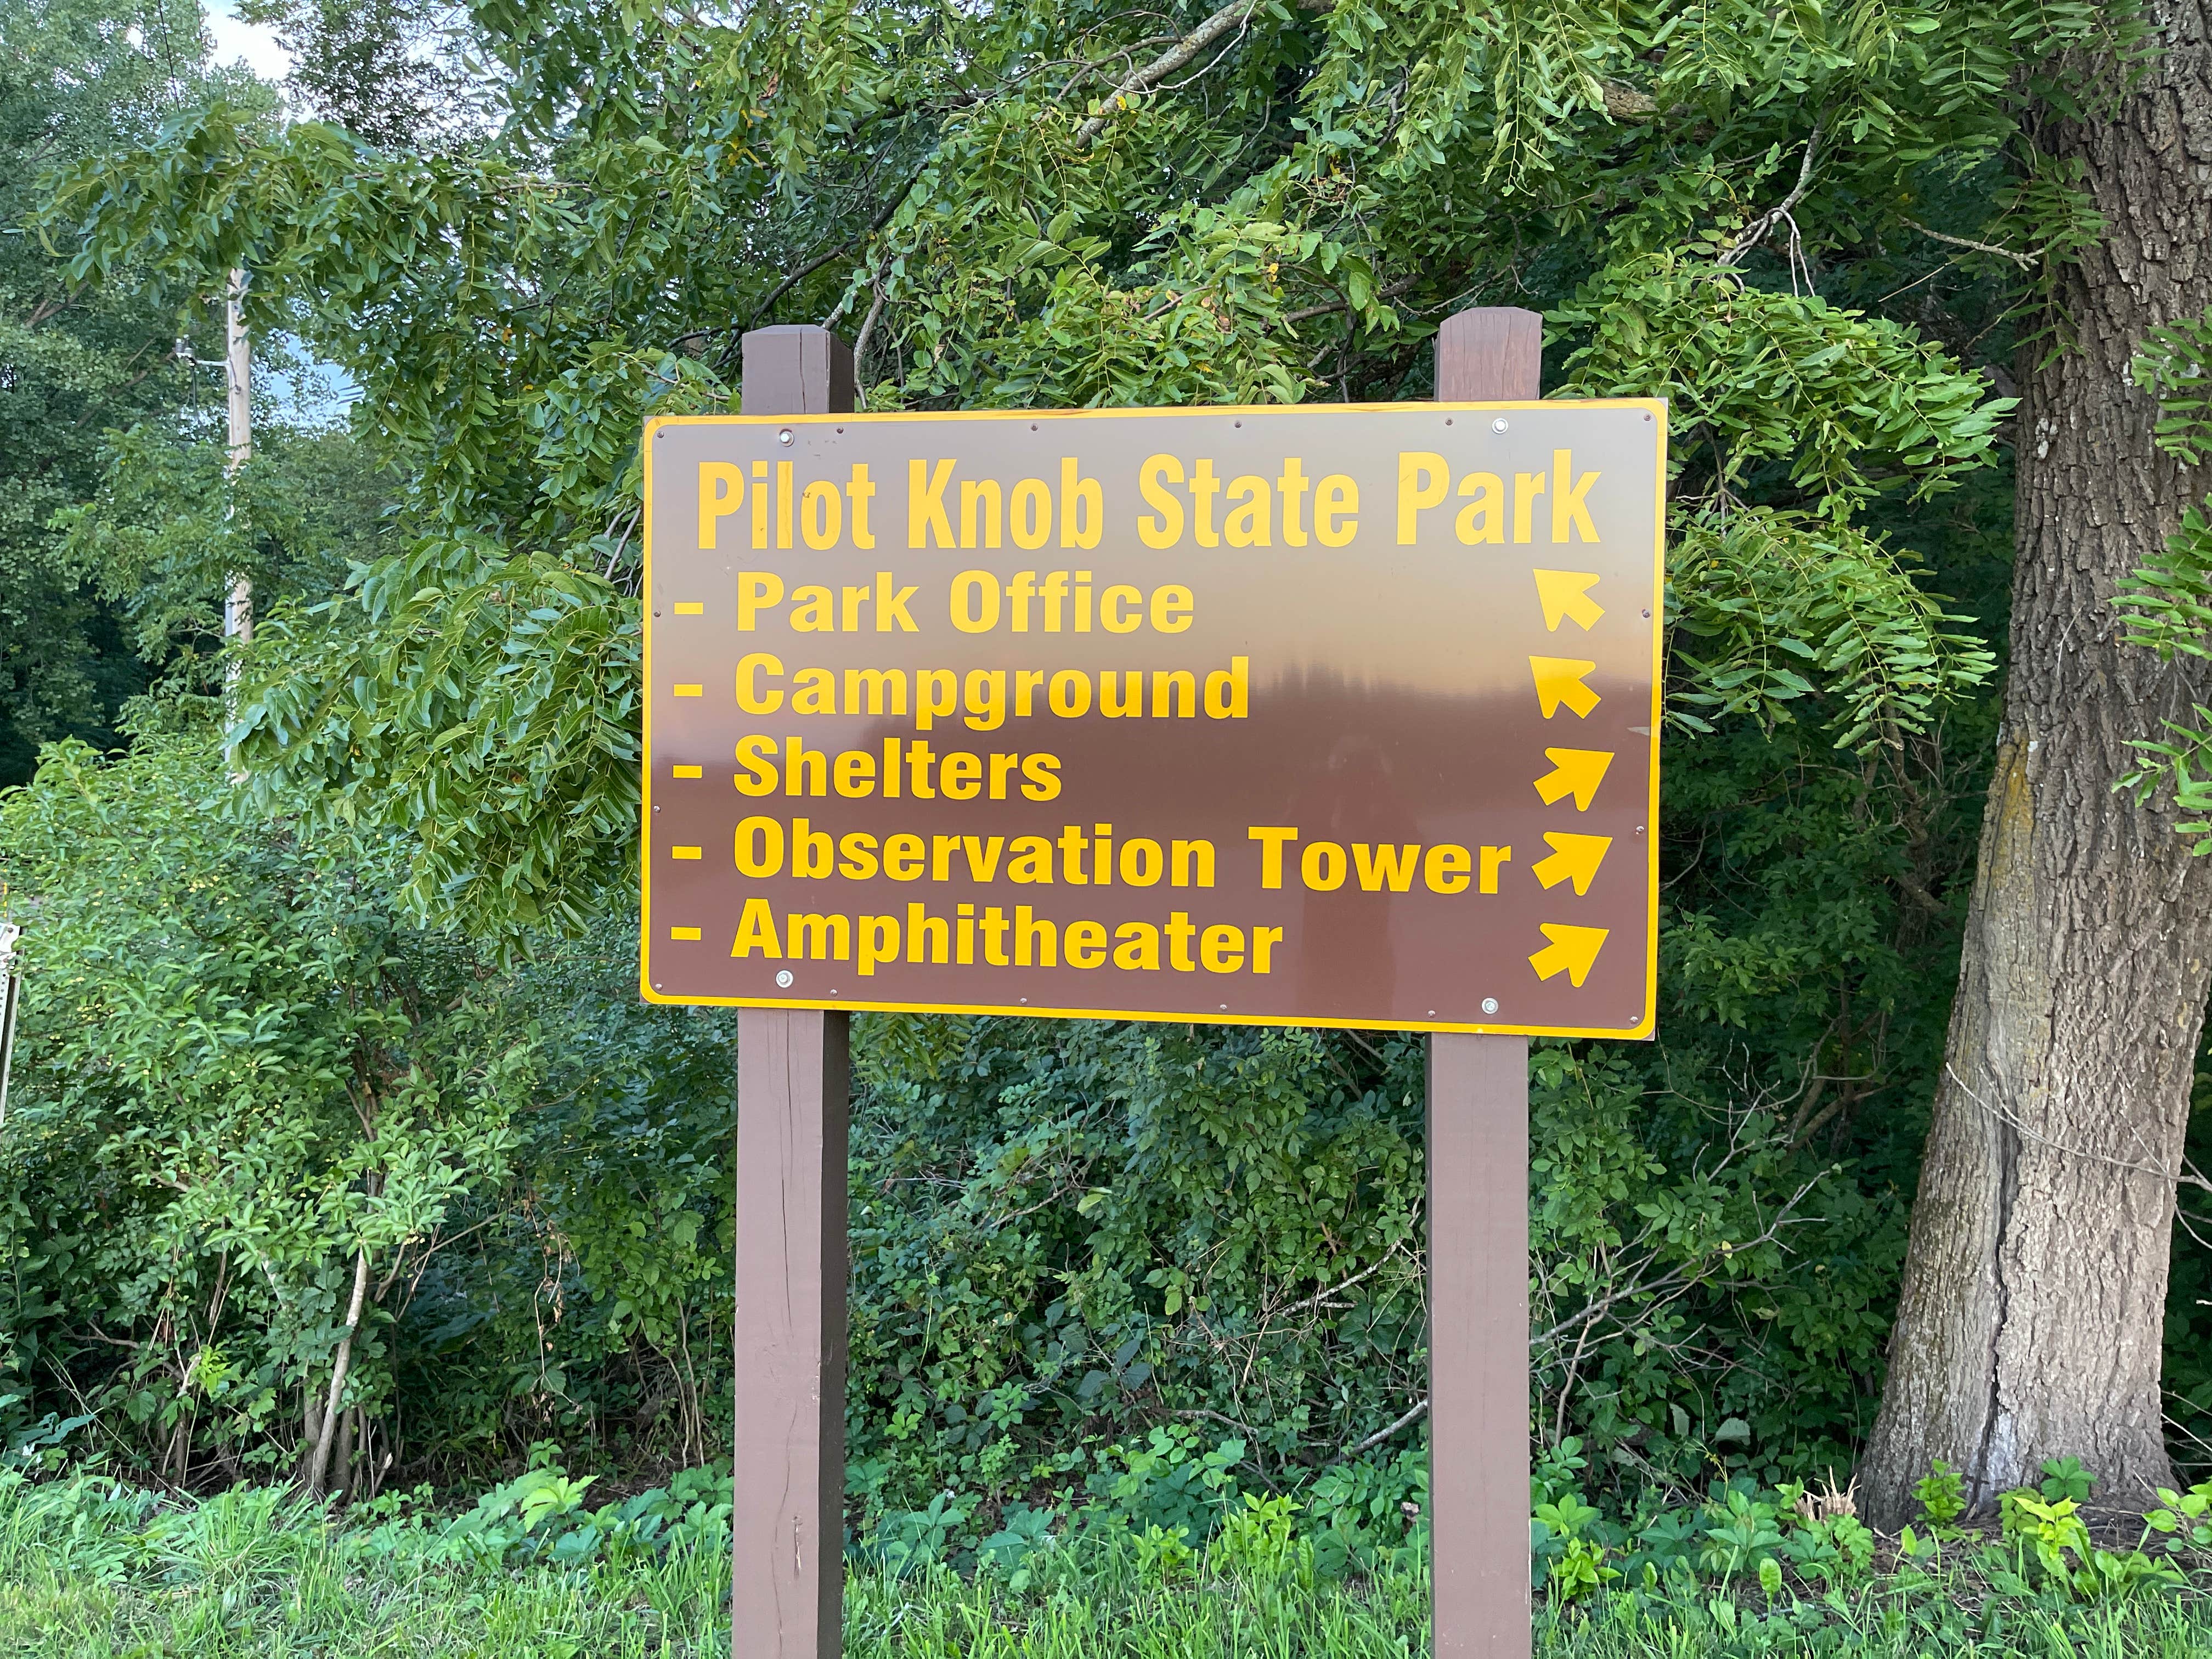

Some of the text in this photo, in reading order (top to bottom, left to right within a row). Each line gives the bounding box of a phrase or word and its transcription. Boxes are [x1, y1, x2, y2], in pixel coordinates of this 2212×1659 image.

[698, 449, 1600, 550] Pilot Knob State Park
[737, 571, 919, 633] Park
[950, 570, 1194, 634] Office
[735, 652, 1250, 731] Campground
[733, 734, 1062, 802] Shelters
[734, 816, 1215, 888] Observation
[1248, 826, 1511, 894] Tower
[730, 898, 1283, 976] Amphitheater
